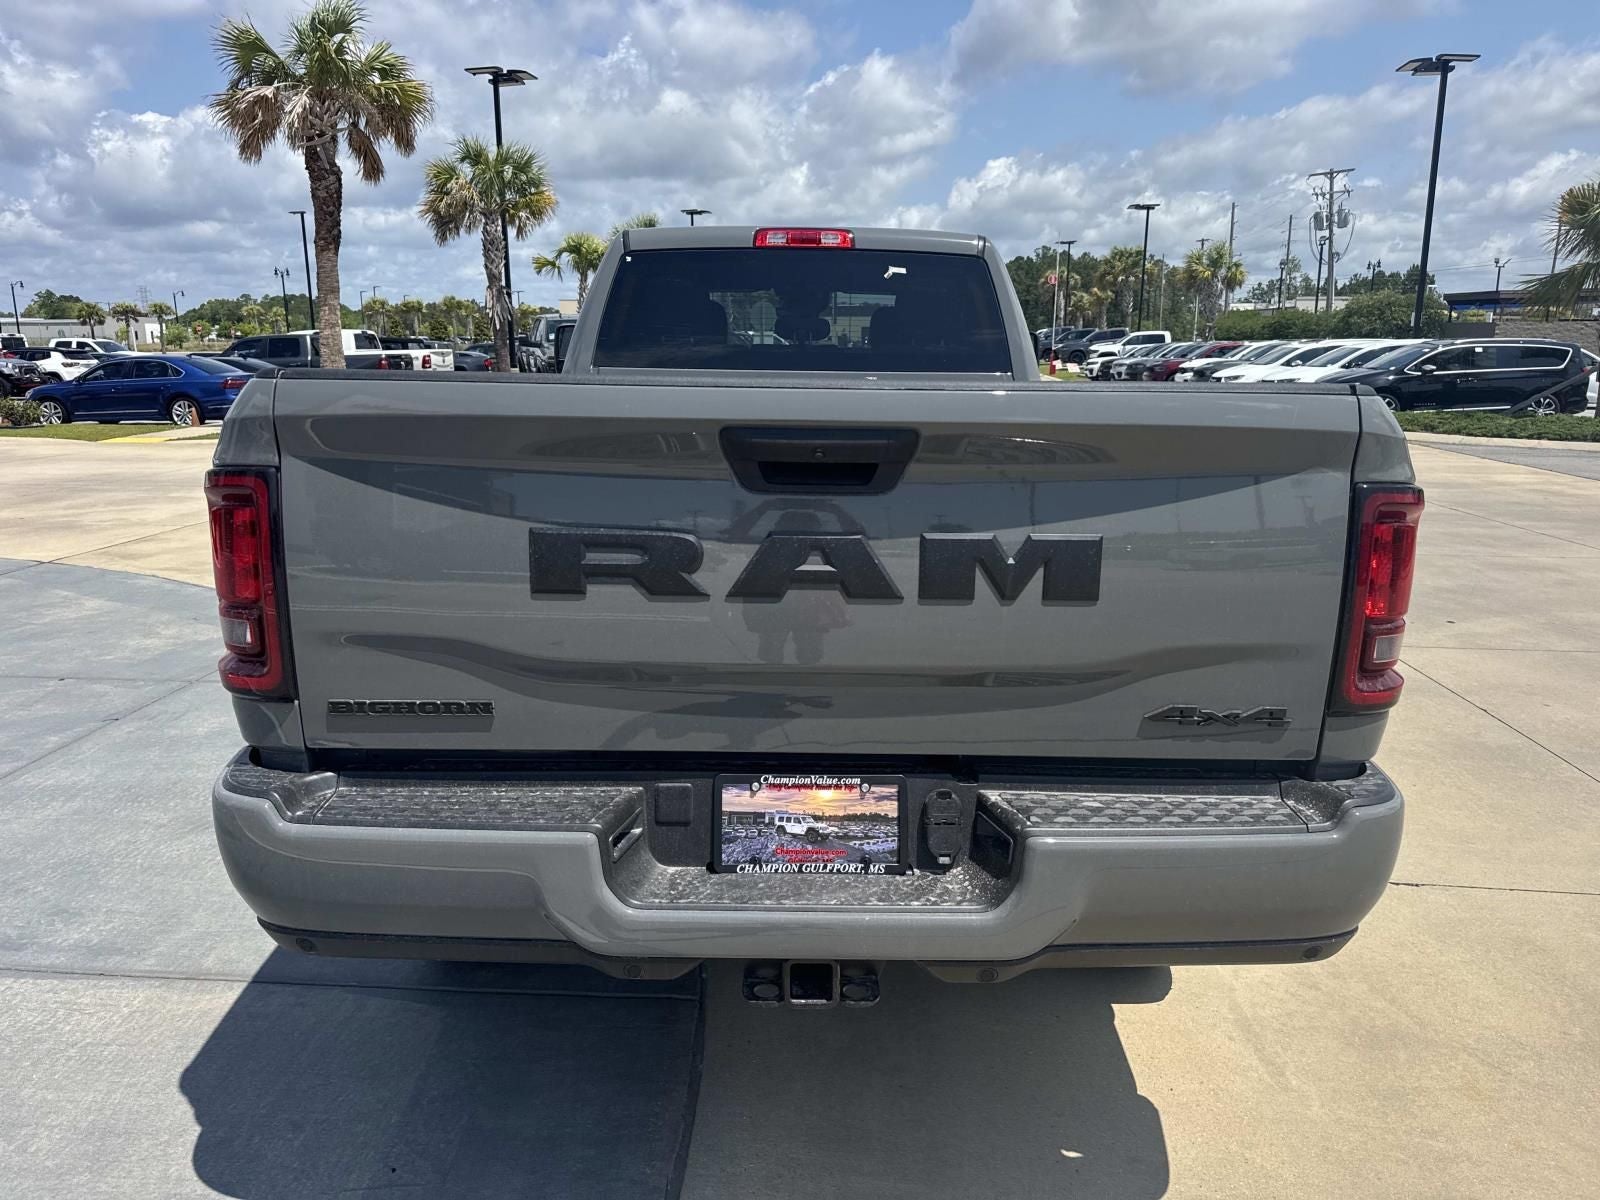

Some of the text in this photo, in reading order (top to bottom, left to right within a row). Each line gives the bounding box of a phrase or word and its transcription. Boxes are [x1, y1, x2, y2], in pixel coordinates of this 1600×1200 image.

[529, 527, 1104, 603] RAM
[327, 698, 496, 716] BIGHORN
[760, 775, 861, 786] ChampionValue.com
[736, 863, 886, 875] CHAMPION GULFPORT, MS
